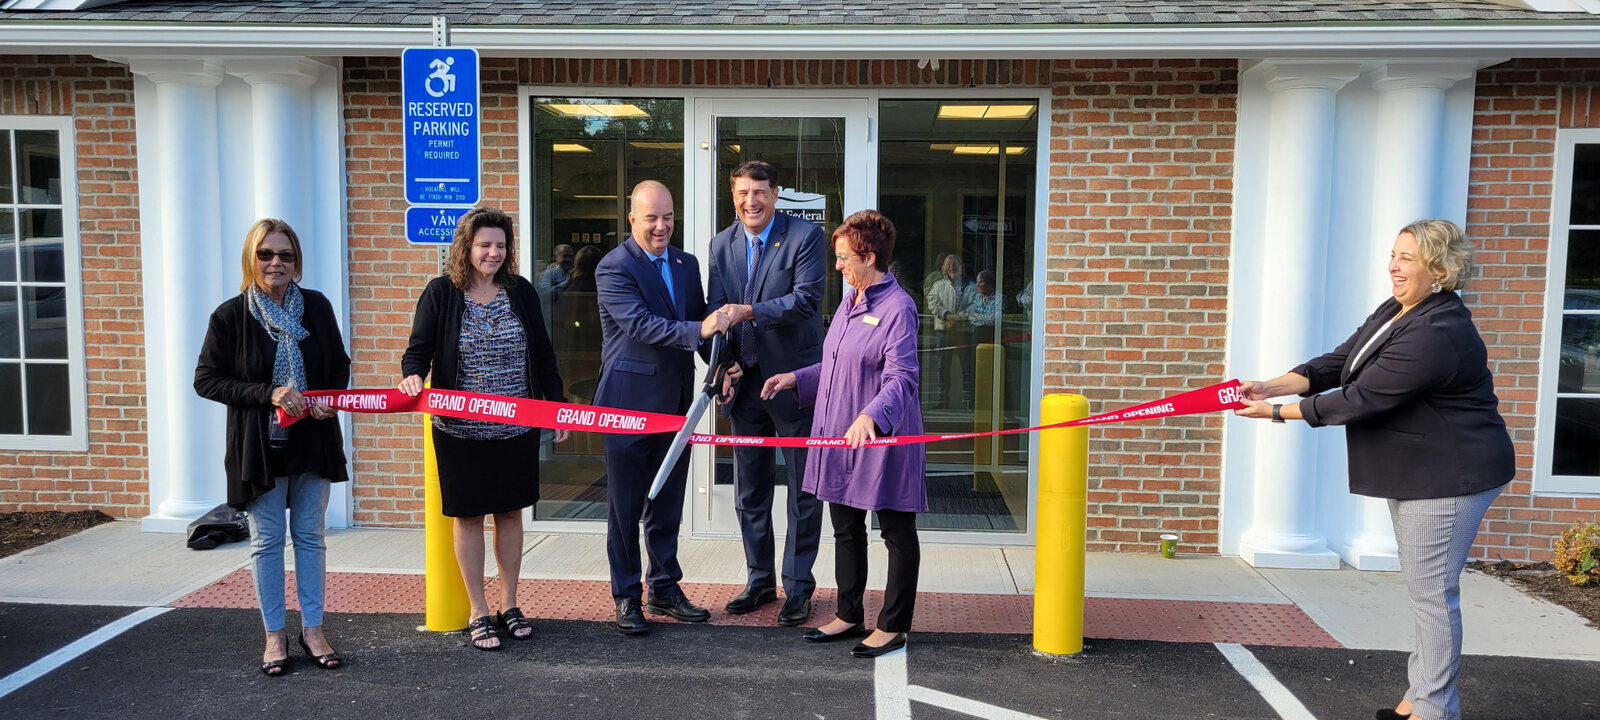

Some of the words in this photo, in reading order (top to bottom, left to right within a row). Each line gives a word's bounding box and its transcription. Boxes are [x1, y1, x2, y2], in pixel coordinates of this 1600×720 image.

[409, 102, 473, 116] RESERVED
[414, 121, 469, 136] PARKING
[424, 151, 460, 159] REQUIRED
[431, 215, 455, 226] VAN
[419, 228, 455, 236] ACCESSI
[304, 395, 333, 408] RAND
[337, 394, 387, 410] OPENING
[1218, 385, 1245, 404] GRA
[428, 393, 466, 411] GRAND
[468, 398, 517, 418] OPENING
[1122, 402, 1175, 417] OPENING
[556, 408, 596, 426] GRAND
[598, 412, 647, 430] OPENING
